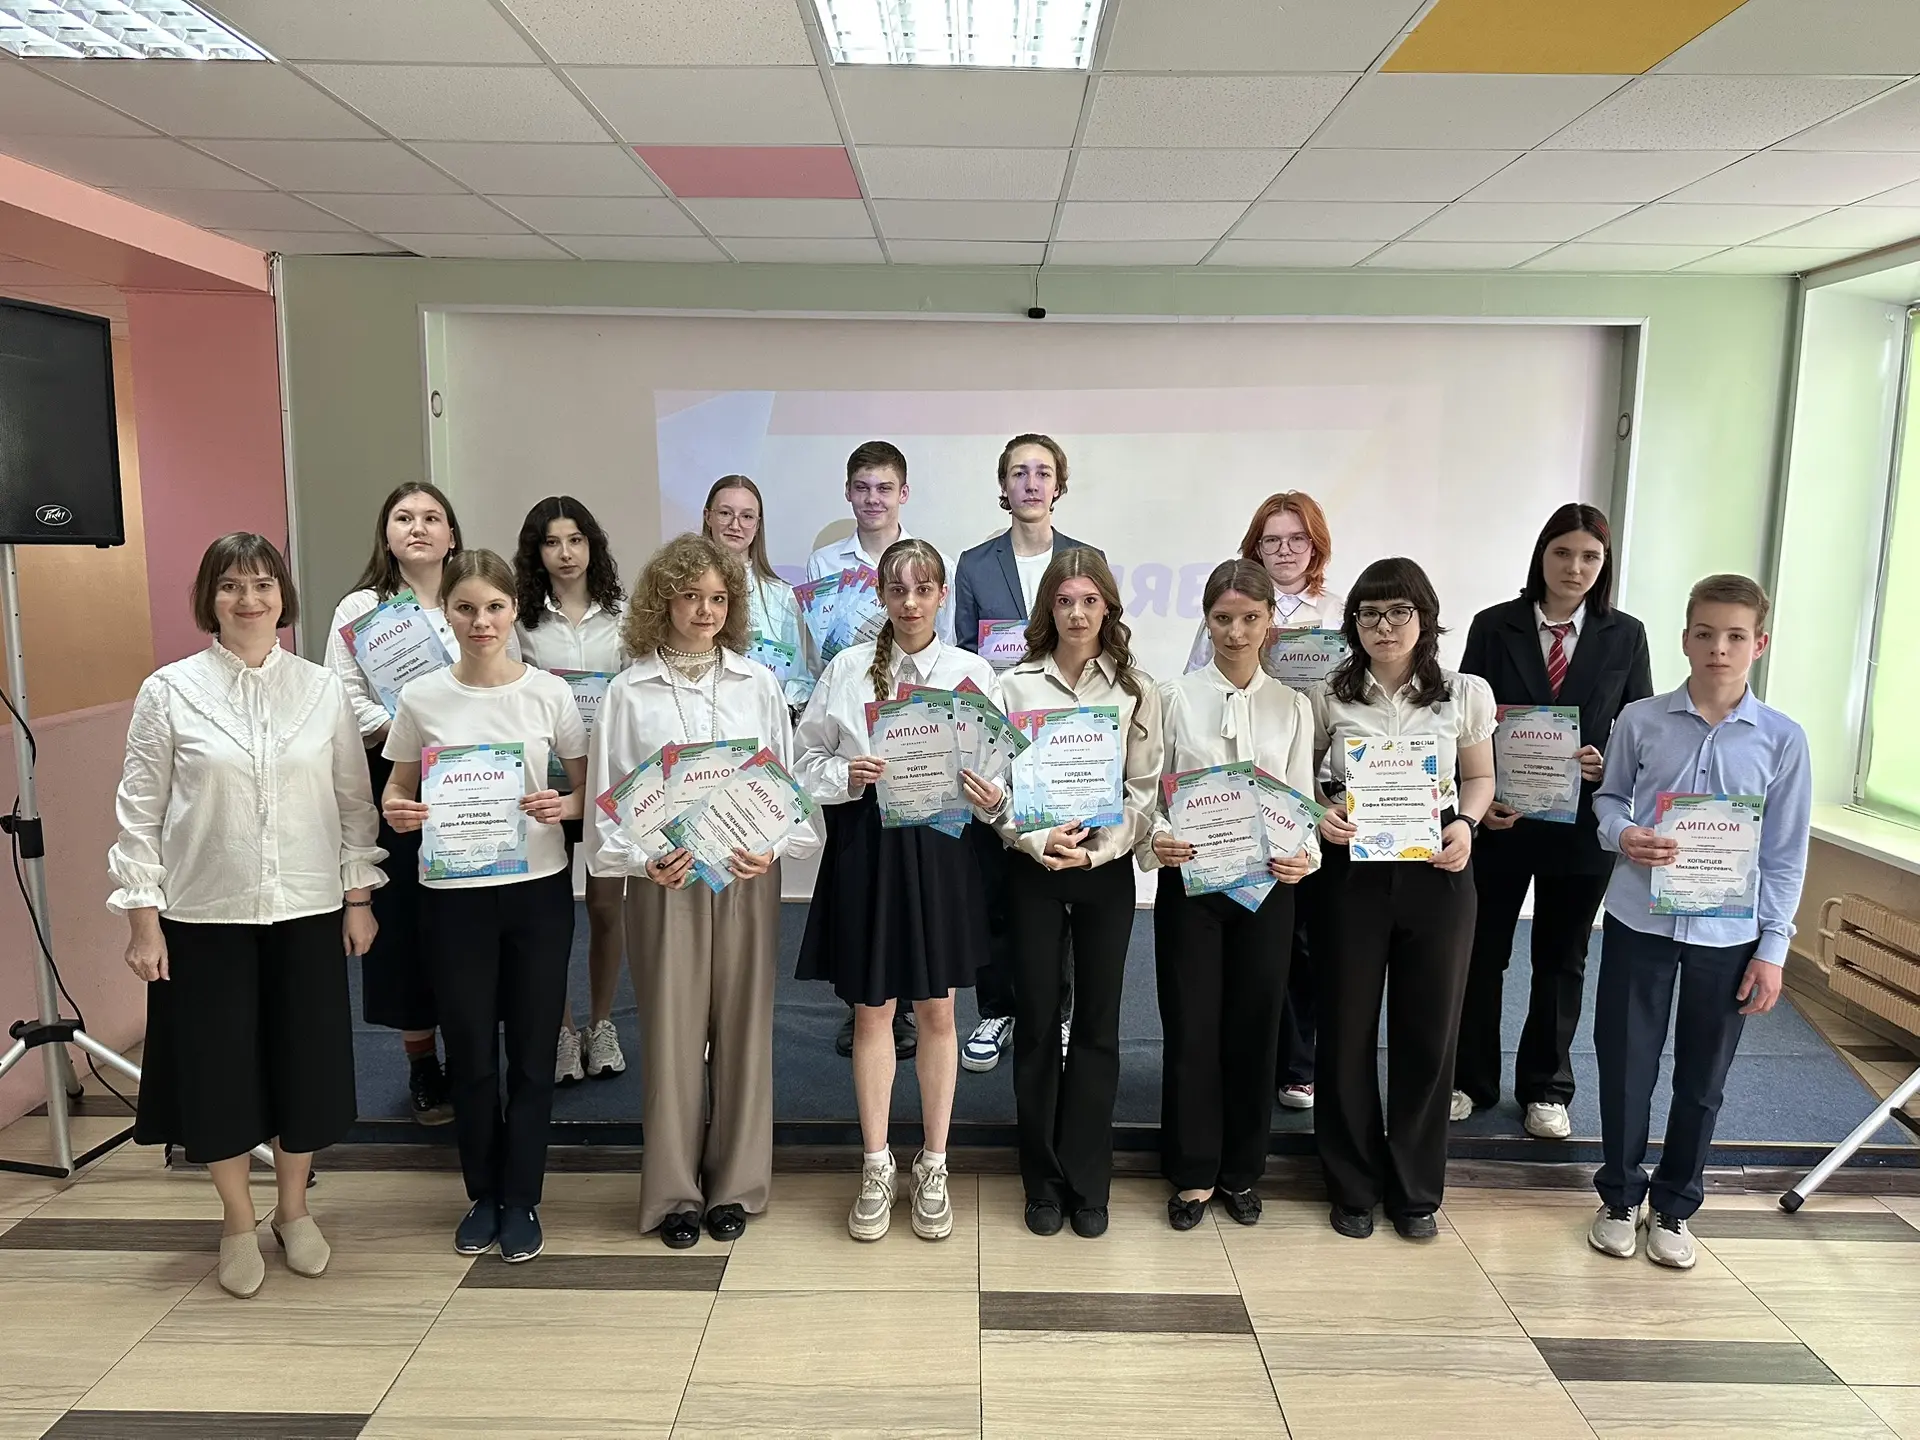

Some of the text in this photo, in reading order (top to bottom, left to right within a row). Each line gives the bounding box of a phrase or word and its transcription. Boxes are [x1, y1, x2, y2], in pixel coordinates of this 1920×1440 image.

[367, 619, 413, 651] ДИПЛОМ
[993, 644, 1029, 652] ДИПЛО
[1280, 653, 1330, 662] ДИПЛОМ
[885, 724, 939, 740] ДИПЛОМ
[1511, 730, 1562, 740] ДИПЛОМ
[1050, 733, 1103, 745] ДИПЛОМ
[1369, 759, 1413, 768] ДИПЛОМ
[442, 771, 504, 784] ДИПЛОМ
[634, 784, 664, 817] ДИПЛ
[746, 779, 785, 822] ДИПЛОМ
[1186, 791, 1241, 810] ДИПЛОМ
[457, 811, 491, 819] АРТЕМОВА
[1261, 804, 1296, 831] ПЛОМ
[725, 811, 747, 837] ПЛЕХАНОВА
[1675, 821, 1740, 832] ДИПЛОМ
[1208, 830, 1233, 839] ФОМИНА
[1193, 839, 1222, 848] лександра
